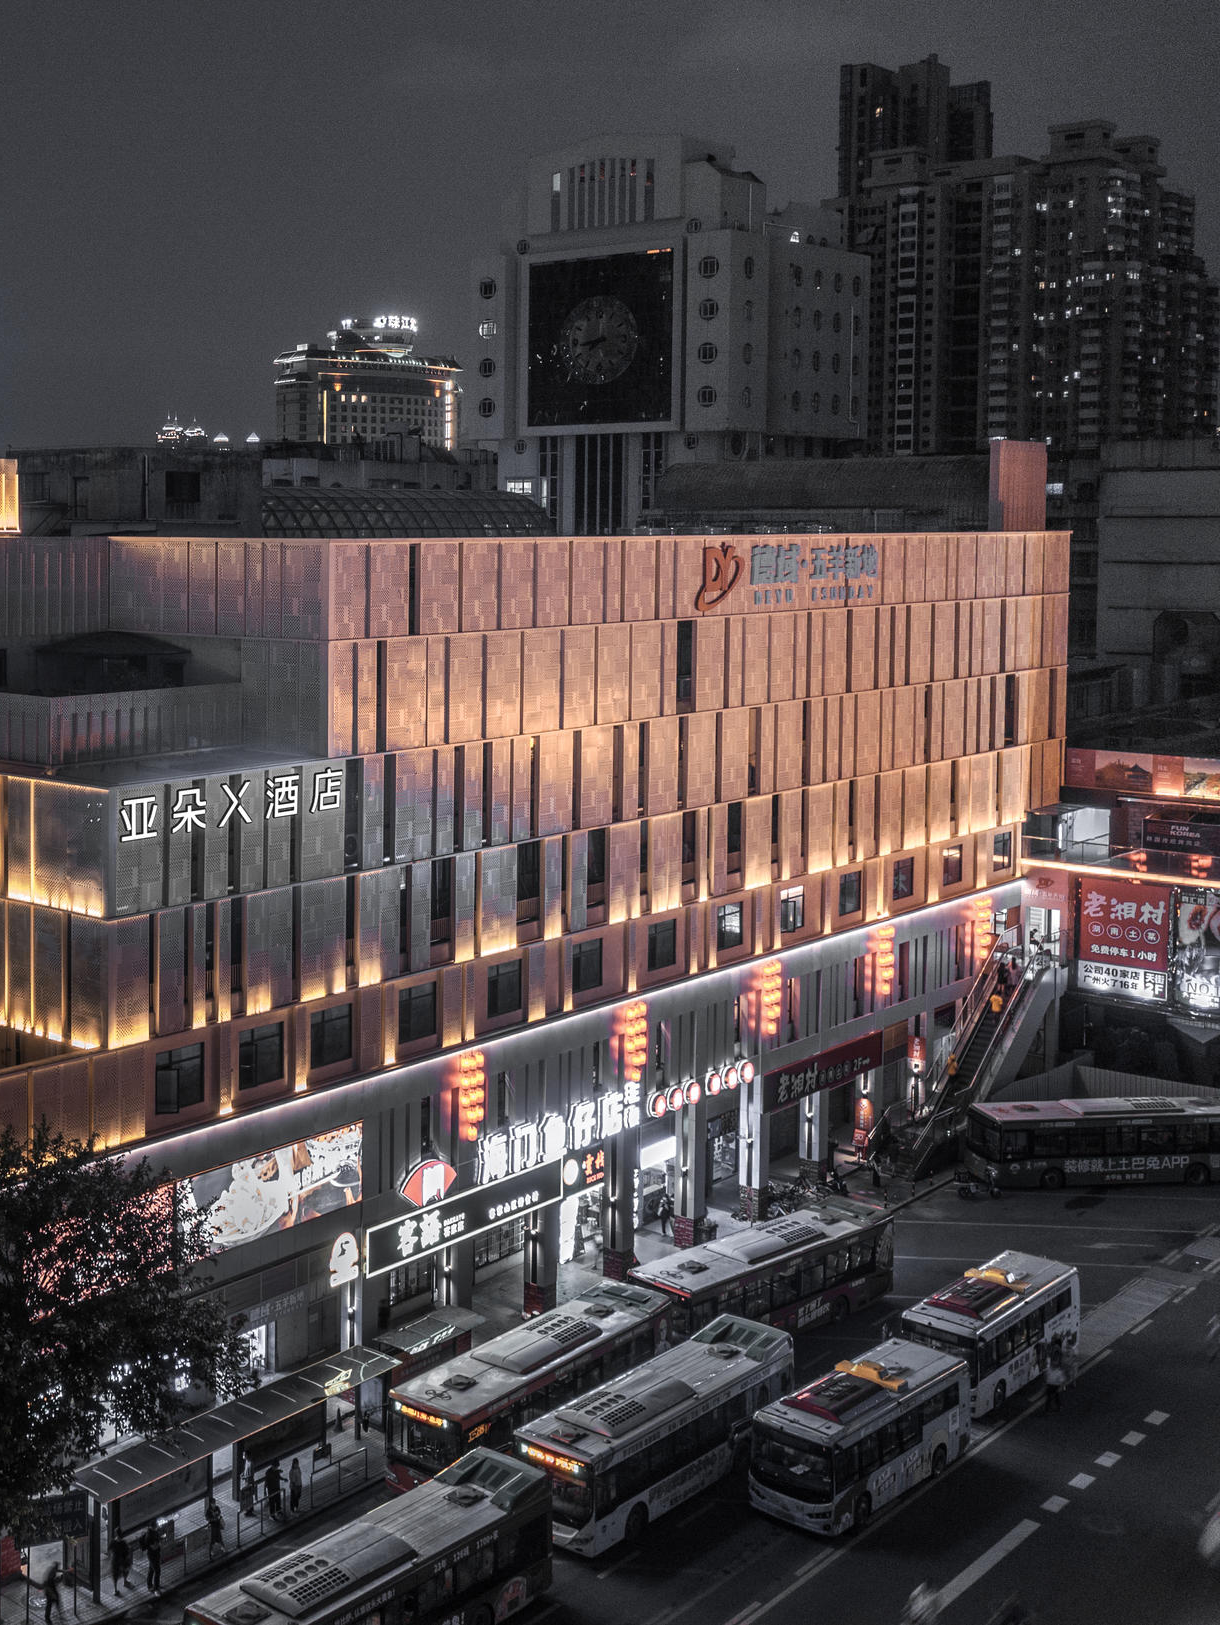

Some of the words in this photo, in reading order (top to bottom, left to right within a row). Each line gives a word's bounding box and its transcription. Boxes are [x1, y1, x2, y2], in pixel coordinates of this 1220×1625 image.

[1084, 890, 1166, 926] 老湘村
[1088, 921, 1161, 945] 湖南土菜
[1090, 943, 1157, 962] 免费停车1小时
[1083, 964, 1140, 980] 公司40家店
[1084, 974, 1138, 990] 广州火了16年
[779, 1061, 819, 1103] 老湘村
